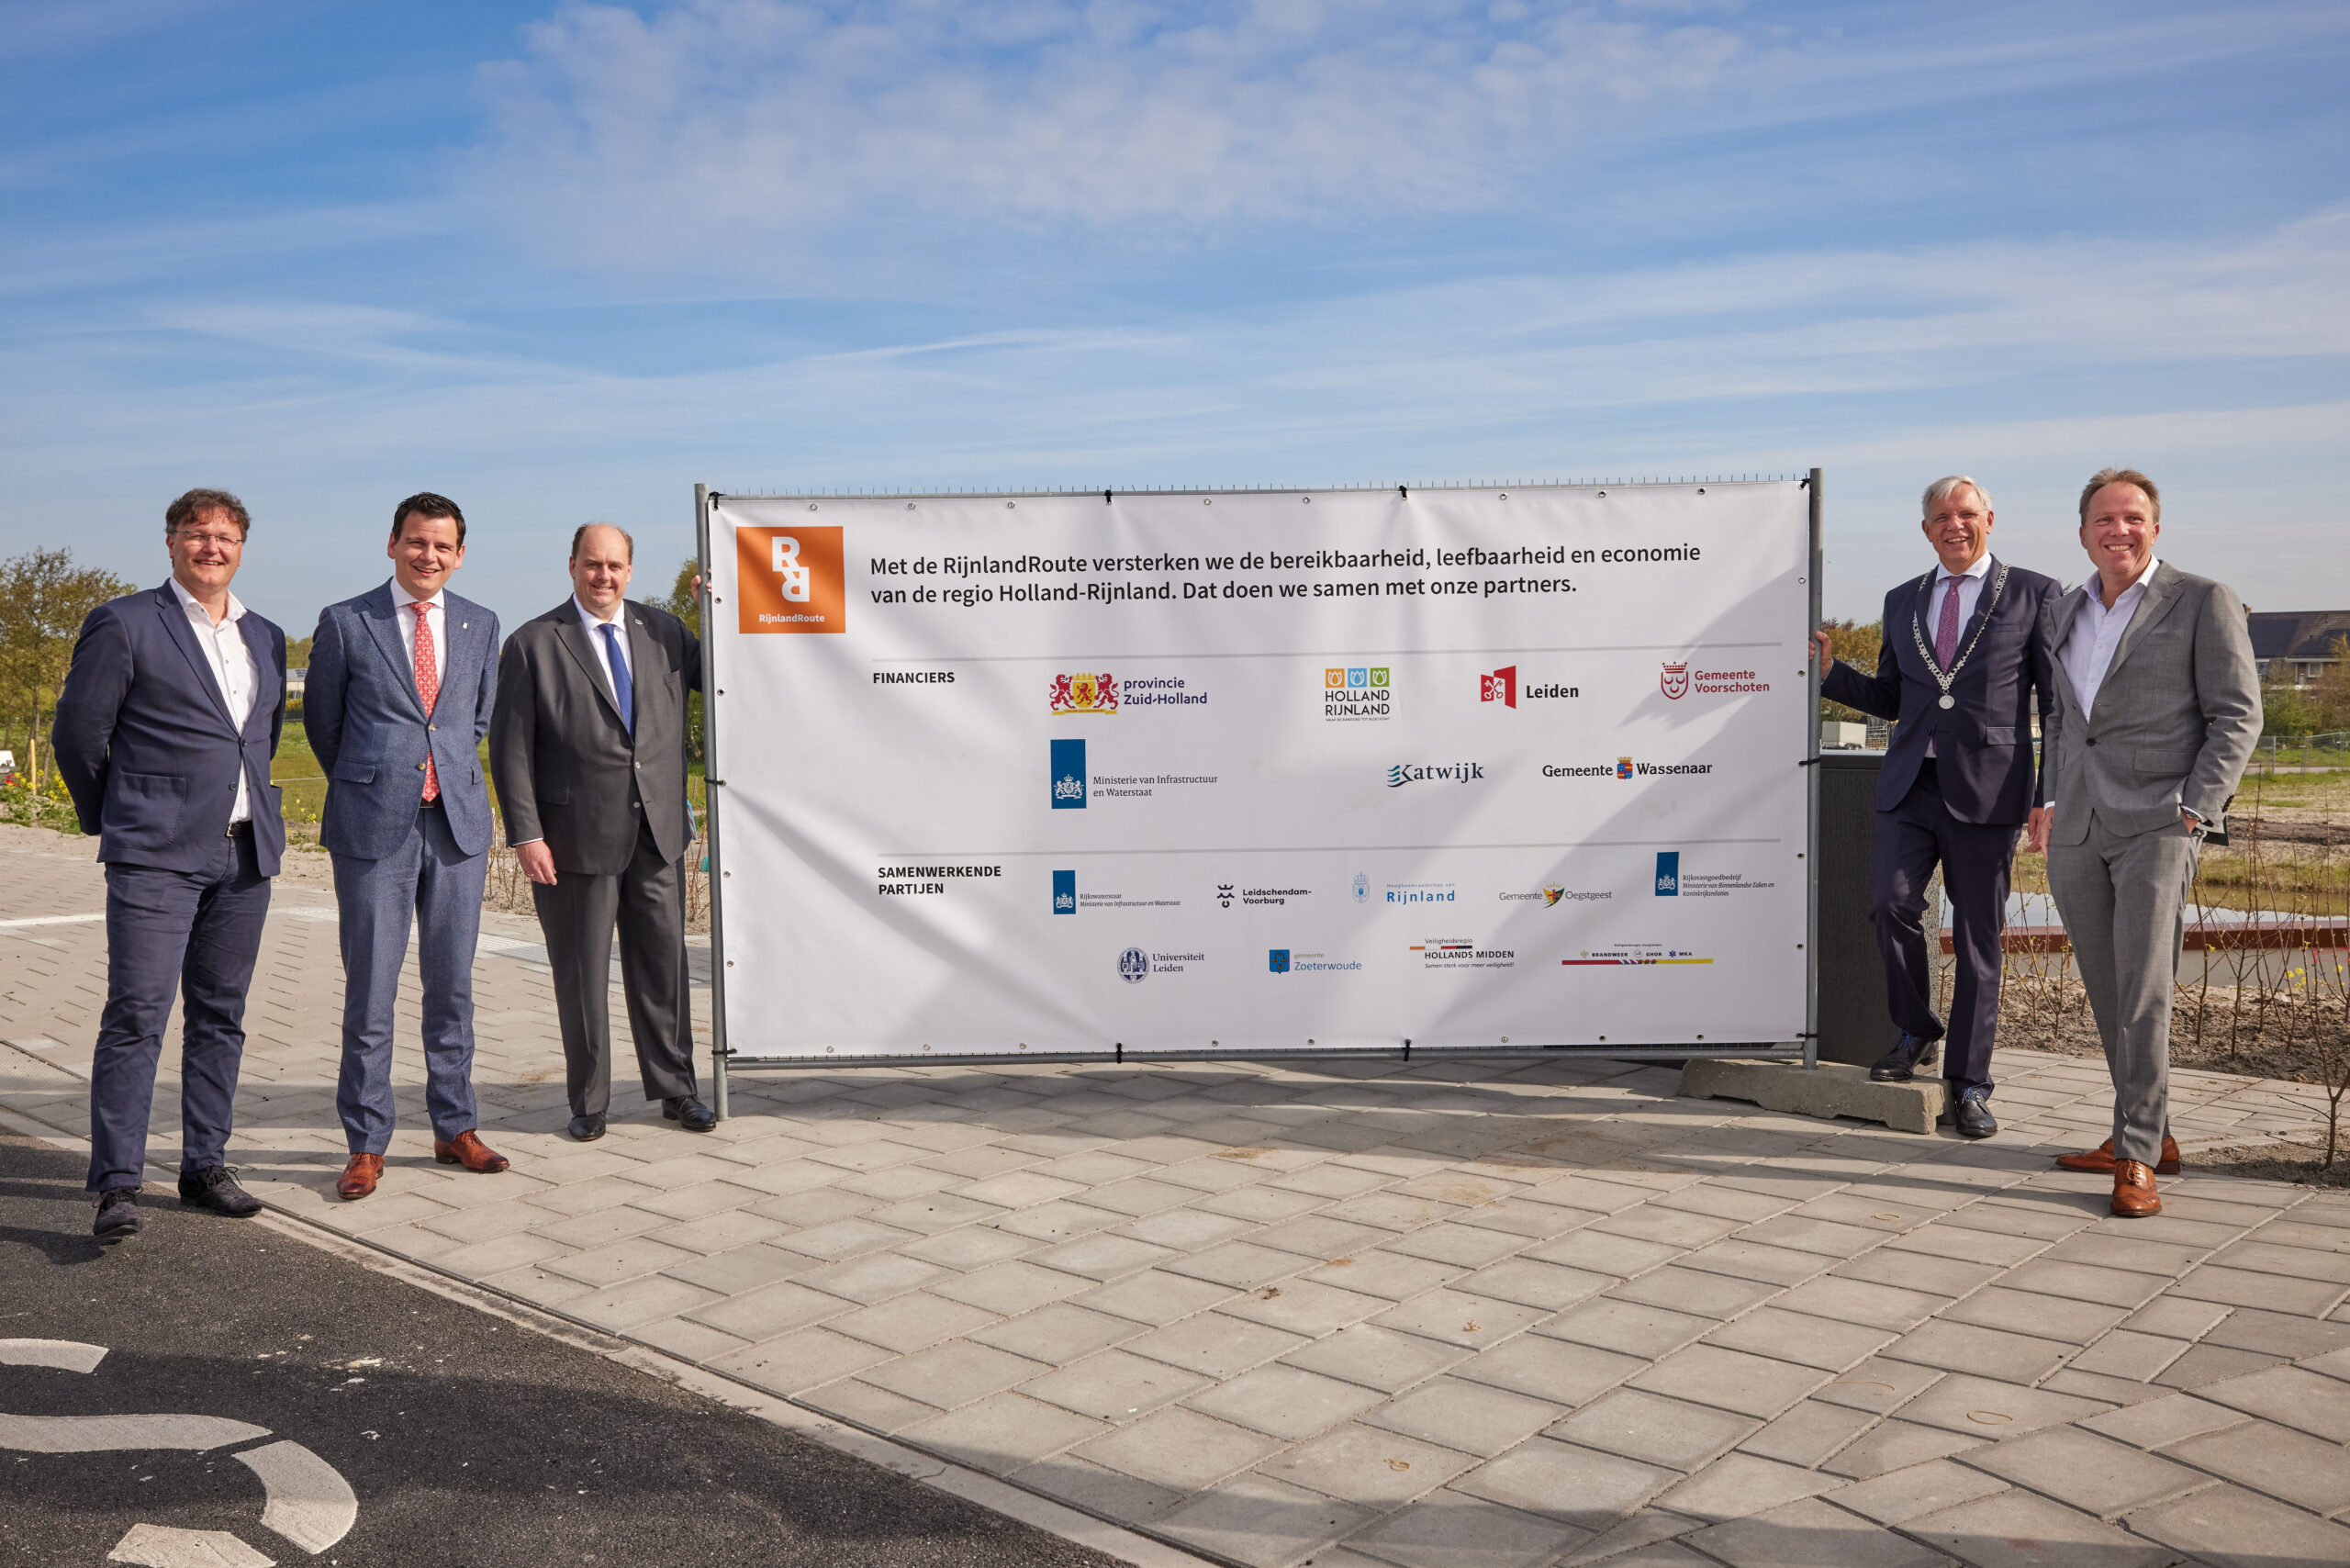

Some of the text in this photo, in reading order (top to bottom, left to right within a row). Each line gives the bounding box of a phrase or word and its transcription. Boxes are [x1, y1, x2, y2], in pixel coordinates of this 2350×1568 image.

[870, 543, 1701, 579] Met de RijnlandRoute versterken we de bereikbaarheid, leefbaarheid en economie
[870, 577, 1577, 608] van de regio Holland-Rijnland. Dat doen we samen met onze partners.
[758, 613, 825, 624] RijnlandRoute
[872, 671, 956, 684] FINANCIERS
[1694, 669, 1756, 681] Gemeente
[1124, 677, 1185, 692] provincie
[1694, 678, 1770, 694] Voorschoten
[1325, 689, 1391, 702] HOLLAND
[1526, 683, 1579, 699] Leiden
[1124, 692, 1208, 705] Zuid-Holland
[1325, 703, 1390, 716] RIJNLAND
[1386, 760, 1485, 789] Katwijk
[1541, 762, 1713, 778] Gemeente Wassenaar
[1092, 775, 1138, 785] Ministerie
[1157, 774, 1219, 784] Infrastructuur
[1092, 788, 1153, 798] en Waterstaat
[878, 866, 1002, 879] SAMENWERKENDE
[1682, 873, 1742, 882] Rijksvastgoedbedrijf
[878, 882, 944, 896] PARTIJEN
[1242, 888, 1313, 899] Leidschendam-
[1682, 890, 1729, 899] Koninkrijksrelaties
[1242, 896, 1285, 906] Voorburg
[1386, 890, 1455, 905] Rijnland
[1498, 890, 1613, 902] Gemeente Oegstgeest
[1424, 937, 1473, 946] Veiligheidsregio
[1152, 952, 1205, 962] Universiteit
[1425, 950, 1515, 959] HOLLANDS MIDDEN
[1153, 963, 1184, 973] Leiden
[1293, 960, 1362, 971] Zoeterwoude
